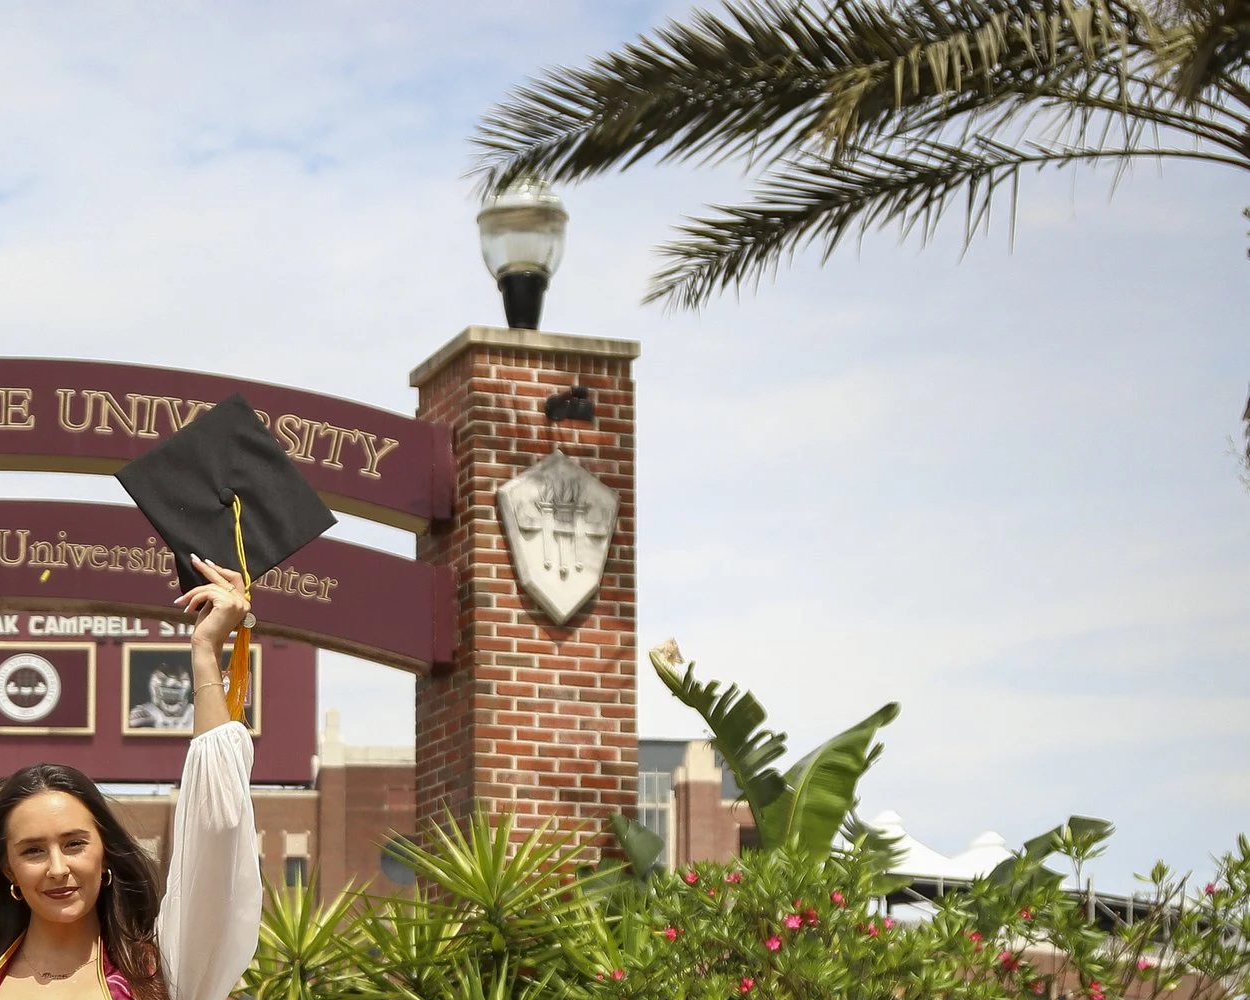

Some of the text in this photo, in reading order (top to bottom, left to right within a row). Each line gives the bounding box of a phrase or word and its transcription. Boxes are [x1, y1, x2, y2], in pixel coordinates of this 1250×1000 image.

[56, 388, 399, 479] UNIVSITY
[254, 565, 338, 601] nter
[28, 615, 149, 637] CAMPBELL
